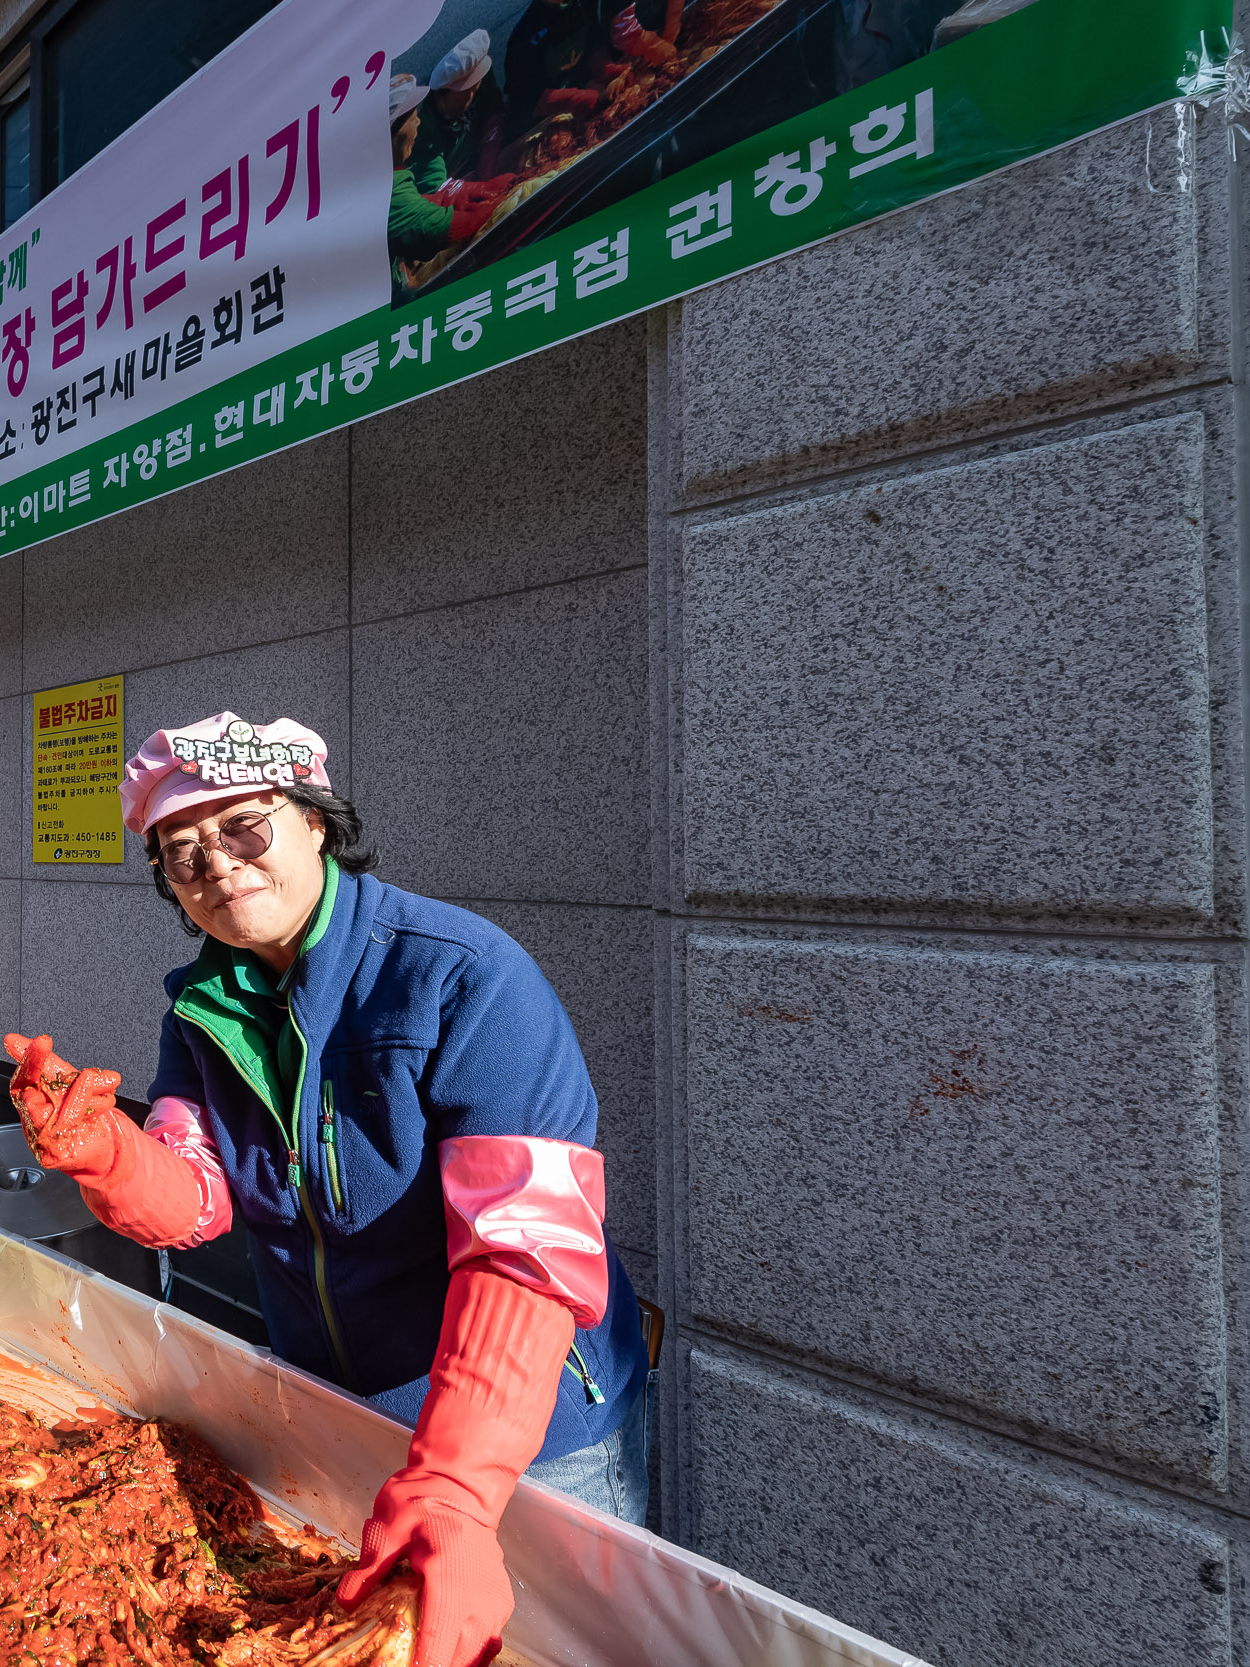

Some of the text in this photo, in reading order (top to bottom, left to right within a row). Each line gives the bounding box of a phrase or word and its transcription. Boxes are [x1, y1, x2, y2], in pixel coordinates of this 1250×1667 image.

[665, 87, 934, 260] 권창희
[38, 694, 117, 729] 불법주차금지
[101, 731, 118, 741] 주차는
[88, 744, 118, 756] 도로교통법
[65, 762, 76, 771] 따라
[78, 760, 98, 770] 20만원
[100, 758, 118, 767] 이하의
[198, 759, 295, 787] 전태연
[37, 785, 118, 800] 불법주차를 금지하여 주시기
[41, 820, 65, 829] 신고전화
[37, 833, 70, 842] 교통지도과
[75, 831, 117, 842] 450-1485
[63, 849, 101, 859] 광진구청장
